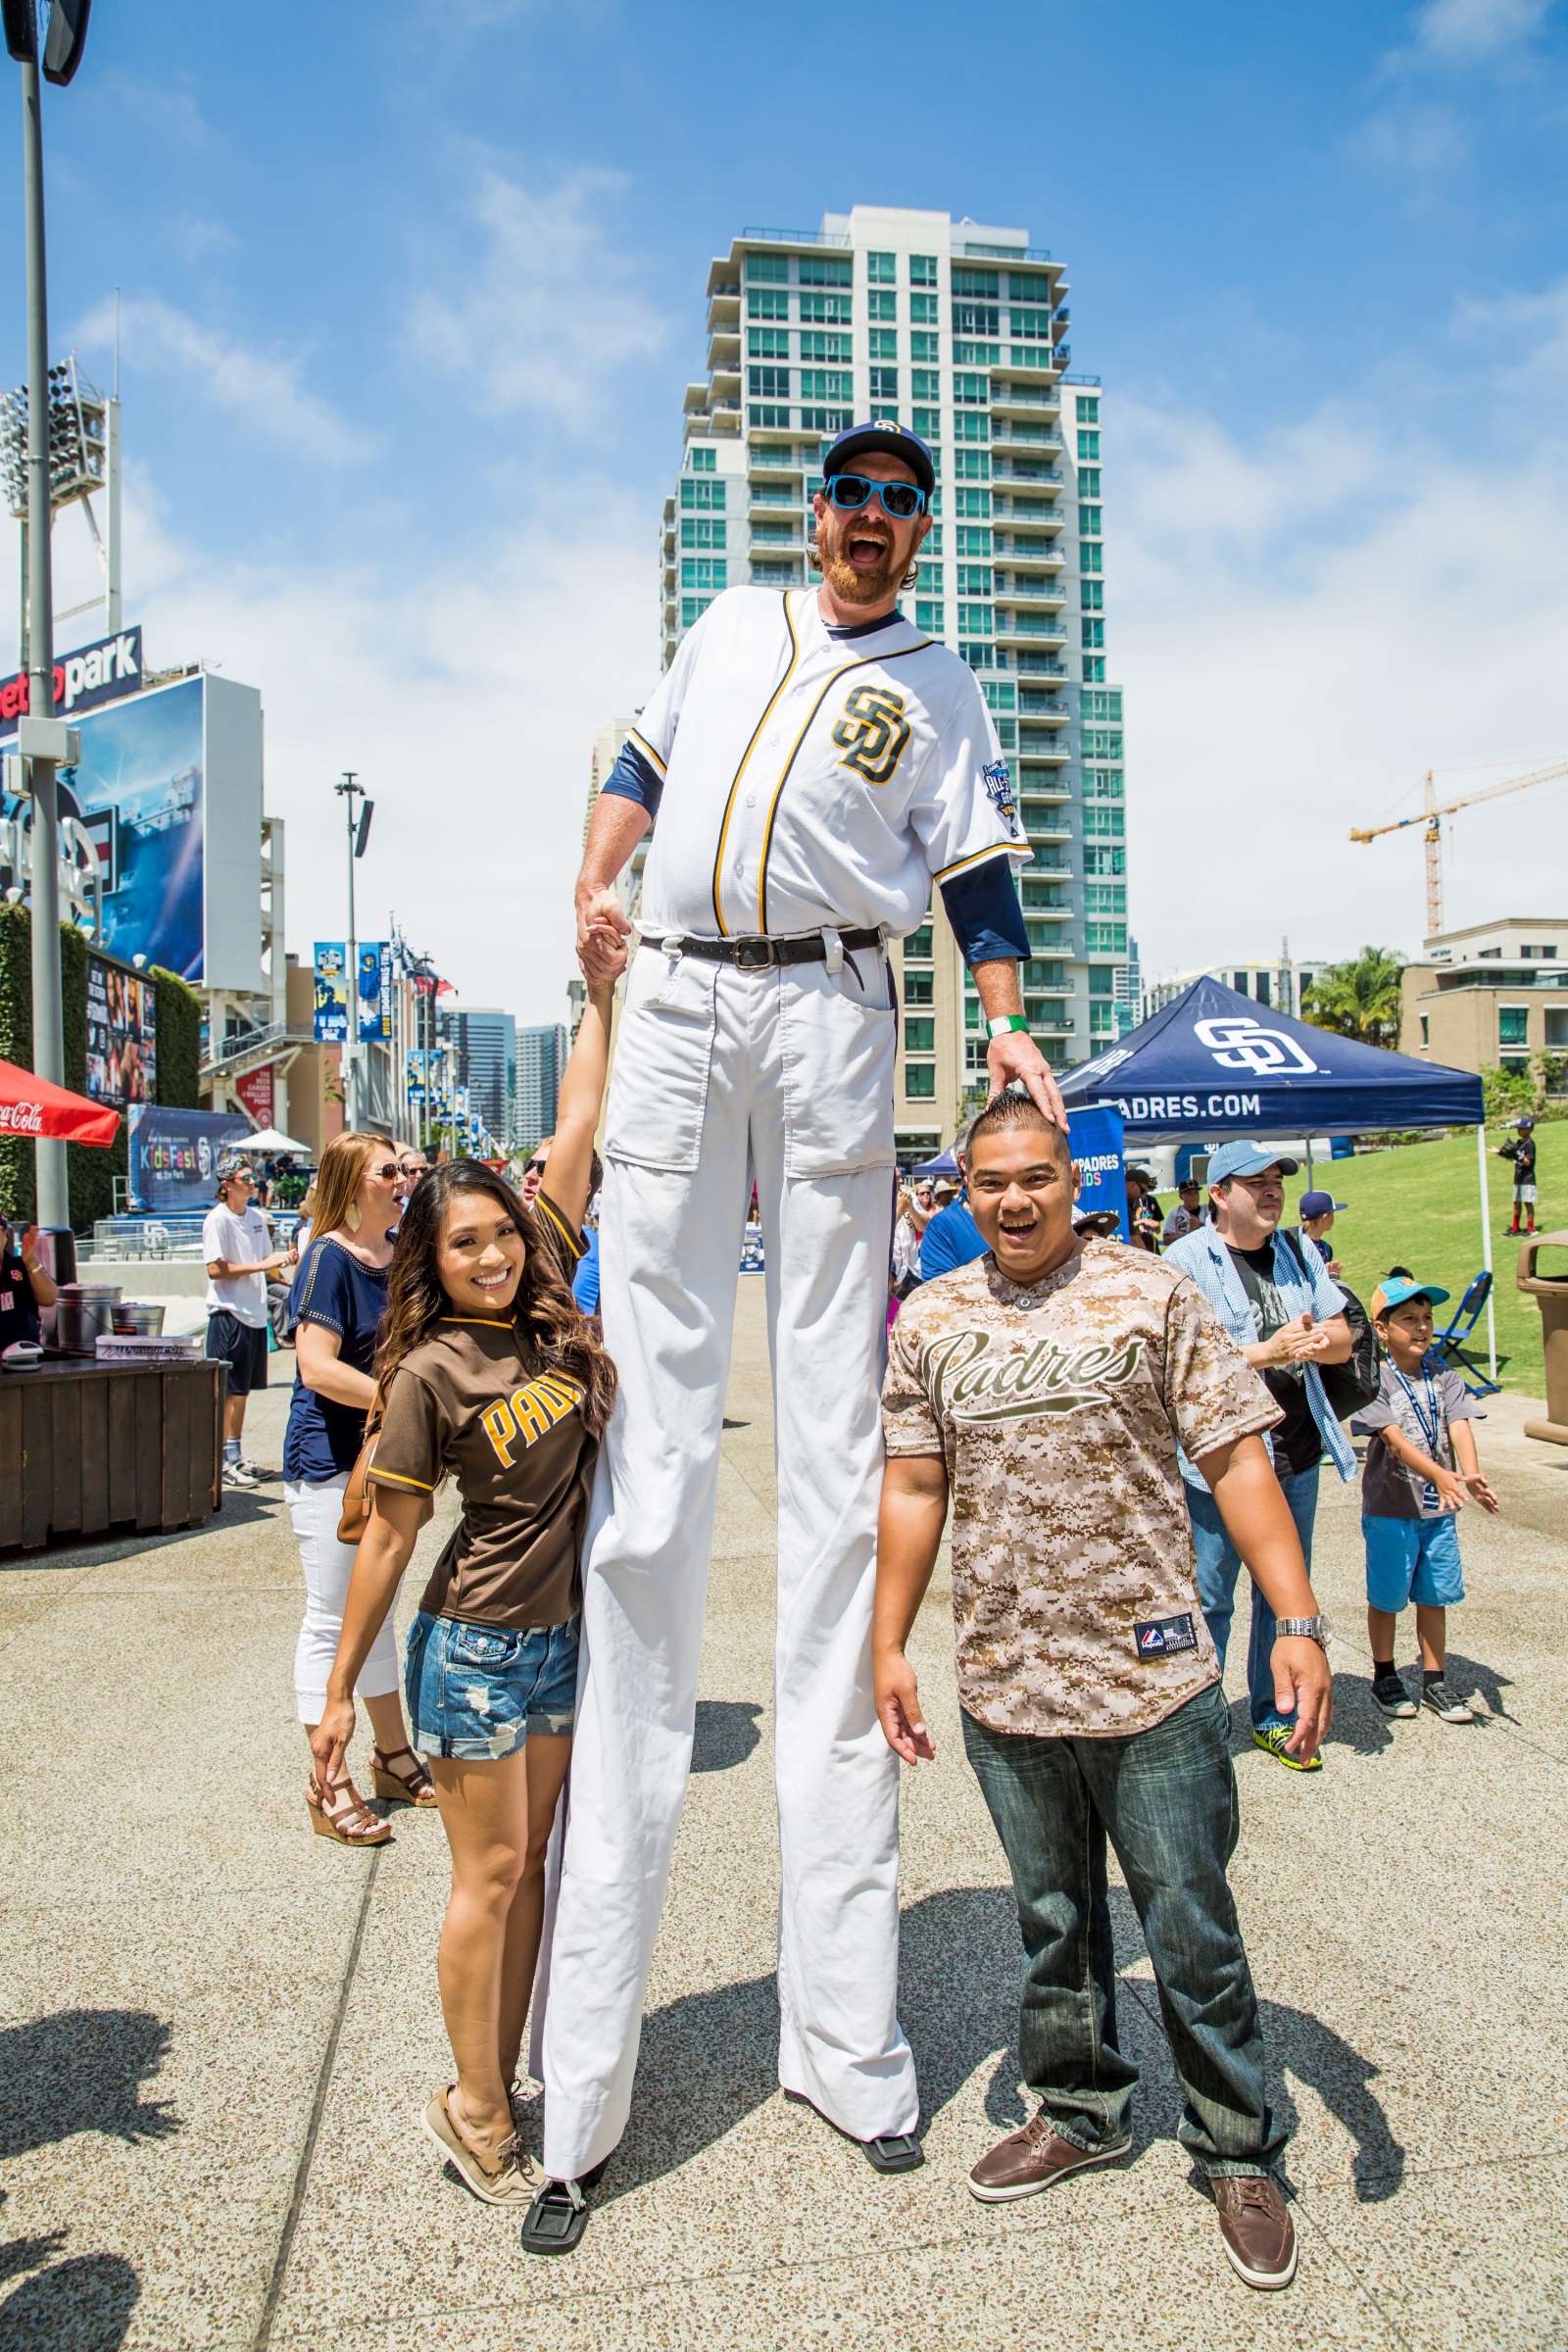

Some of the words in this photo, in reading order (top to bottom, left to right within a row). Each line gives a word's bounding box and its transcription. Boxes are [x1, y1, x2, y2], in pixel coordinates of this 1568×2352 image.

[65, 635, 138, 709] park
[831, 682, 912, 785] SD
[1193, 1017, 1318, 1076] SD
[140, 1145, 196, 1169] KidsFest
[921, 1326, 1147, 1421] Padres
